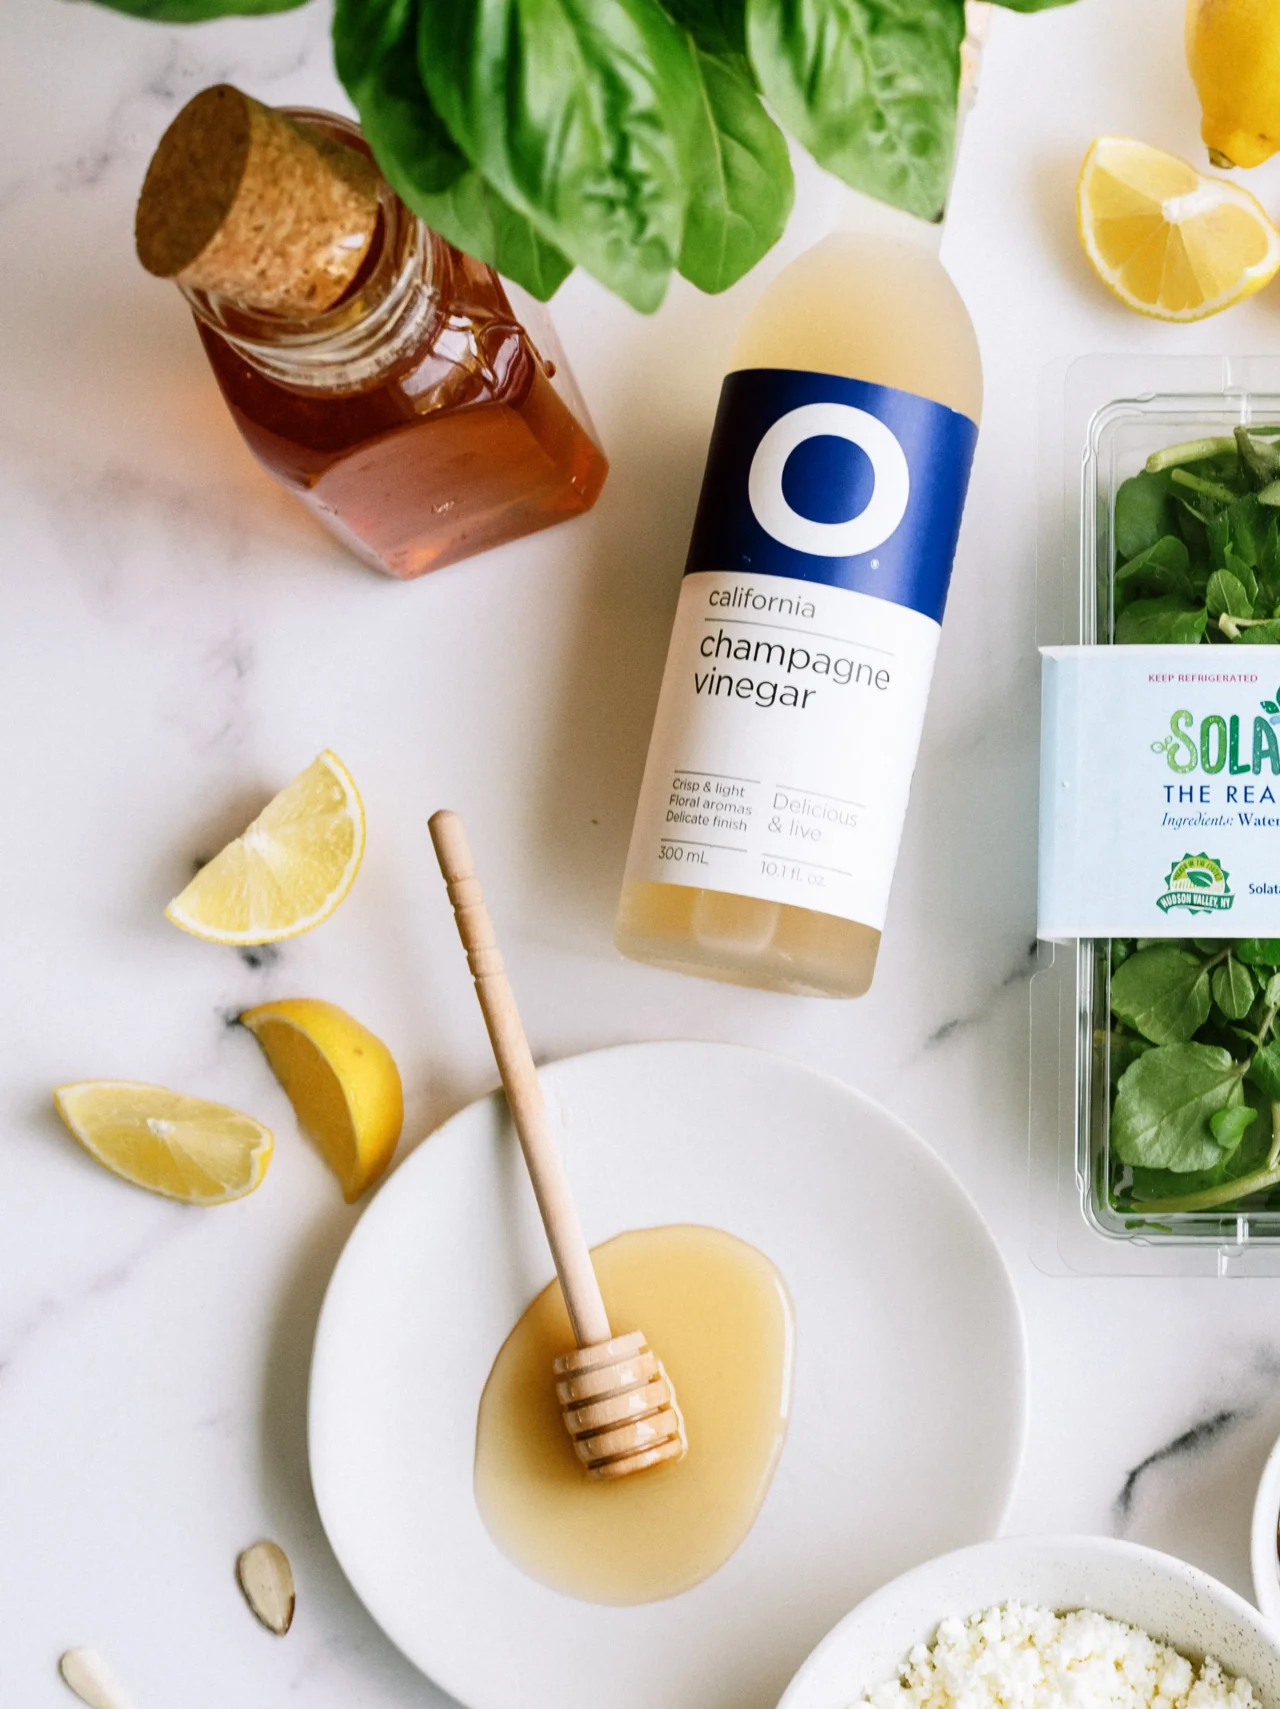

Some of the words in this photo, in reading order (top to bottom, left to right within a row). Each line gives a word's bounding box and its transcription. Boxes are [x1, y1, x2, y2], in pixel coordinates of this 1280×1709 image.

[708, 586, 816, 619] california
[700, 628, 891, 691] champagne
[694, 666, 817, 709] vinegar
[1148, 674, 1174, 683] KEEP
[1178, 674, 1258, 683] REFRIGERATED
[672, 777, 700, 793] Crisp
[702, 779, 712, 793] &
[715, 782, 746, 798] light
[1163, 785, 1211, 803] THE
[669, 793, 700, 809] Floral
[702, 800, 752, 816] aromas
[773, 792, 858, 829] Delicious
[666, 809, 710, 826] Delicate
[712, 815, 748, 832] finish
[768, 815, 782, 834] &
[790, 819, 822, 842] live
[1161, 811, 1234, 830] Ingredients:
[658, 845, 683, 862] 300
[686, 850, 709, 866] mL
[760, 860, 787, 880] 10.1
[1160, 893, 1191, 909] HUDSON
[1193, 893, 1219, 909] VALLEY,
[1220, 897, 1230, 908] NY
